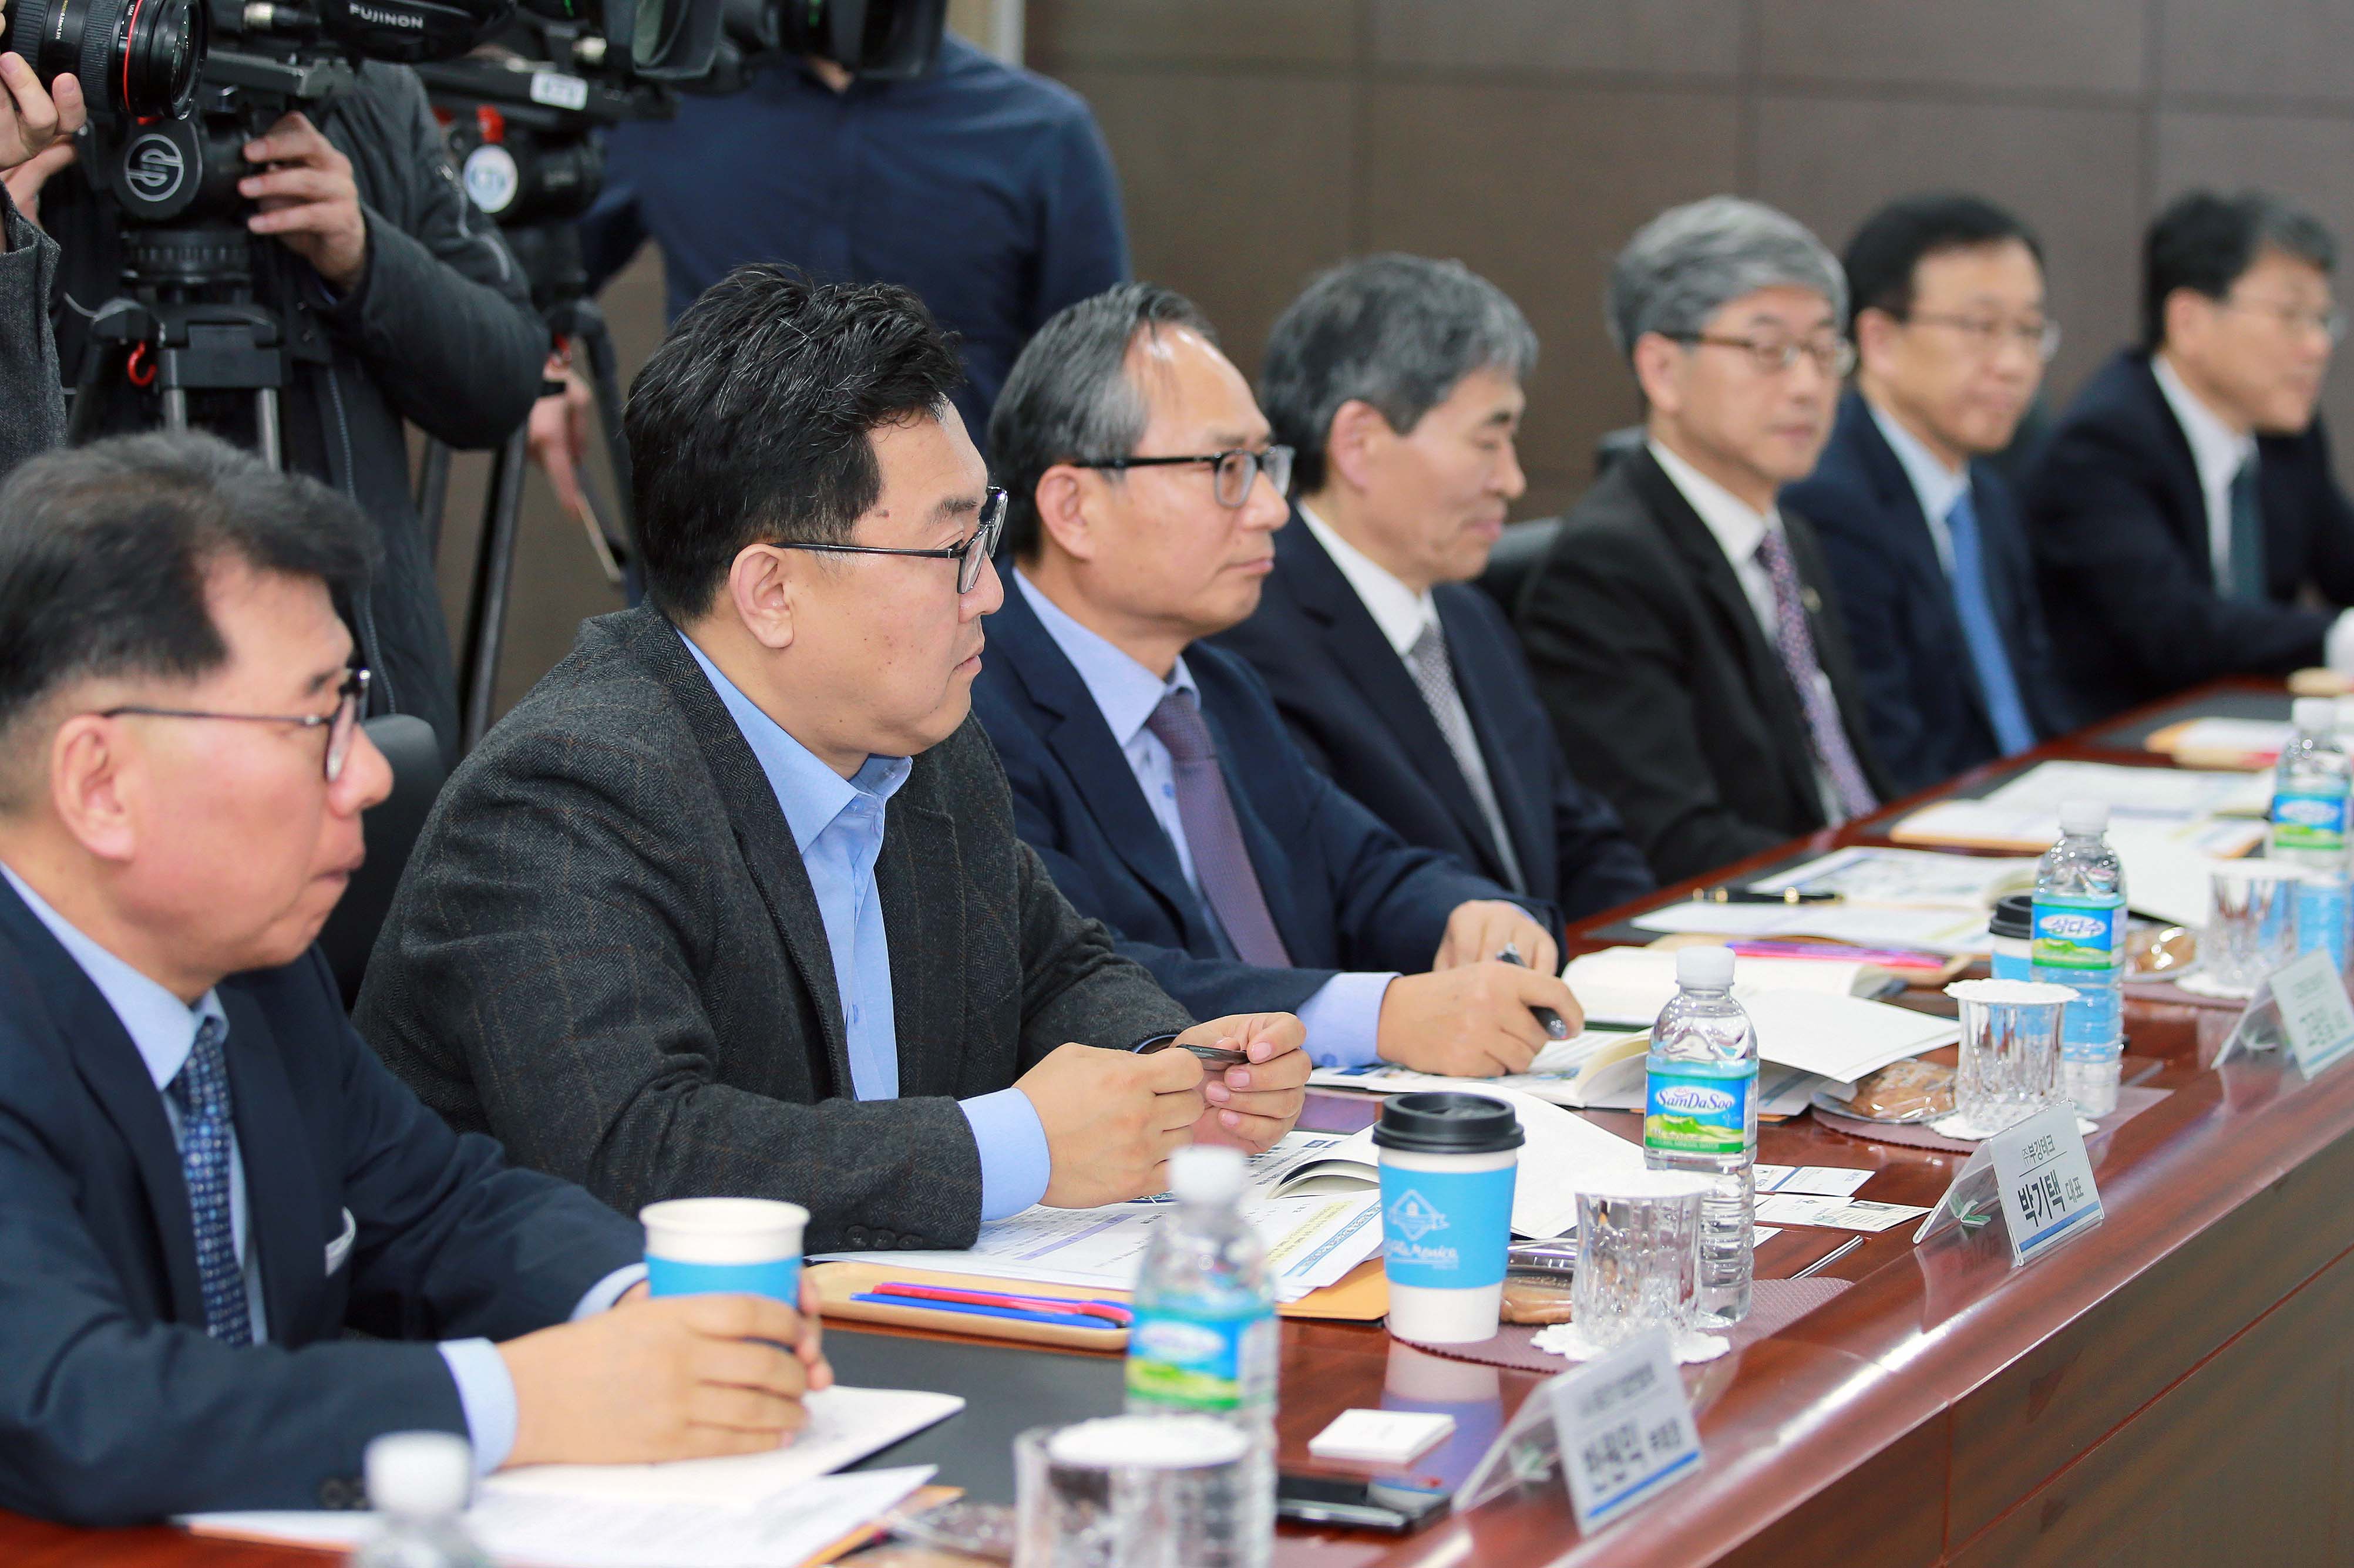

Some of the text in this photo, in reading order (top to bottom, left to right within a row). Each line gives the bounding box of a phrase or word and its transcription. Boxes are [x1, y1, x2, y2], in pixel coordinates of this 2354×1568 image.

[349, 2, 423, 29] FUJINON
[1659, 1089, 1733, 1109] SamDaSoo
[2017, 1169, 2084, 1227] 박기택 대표
